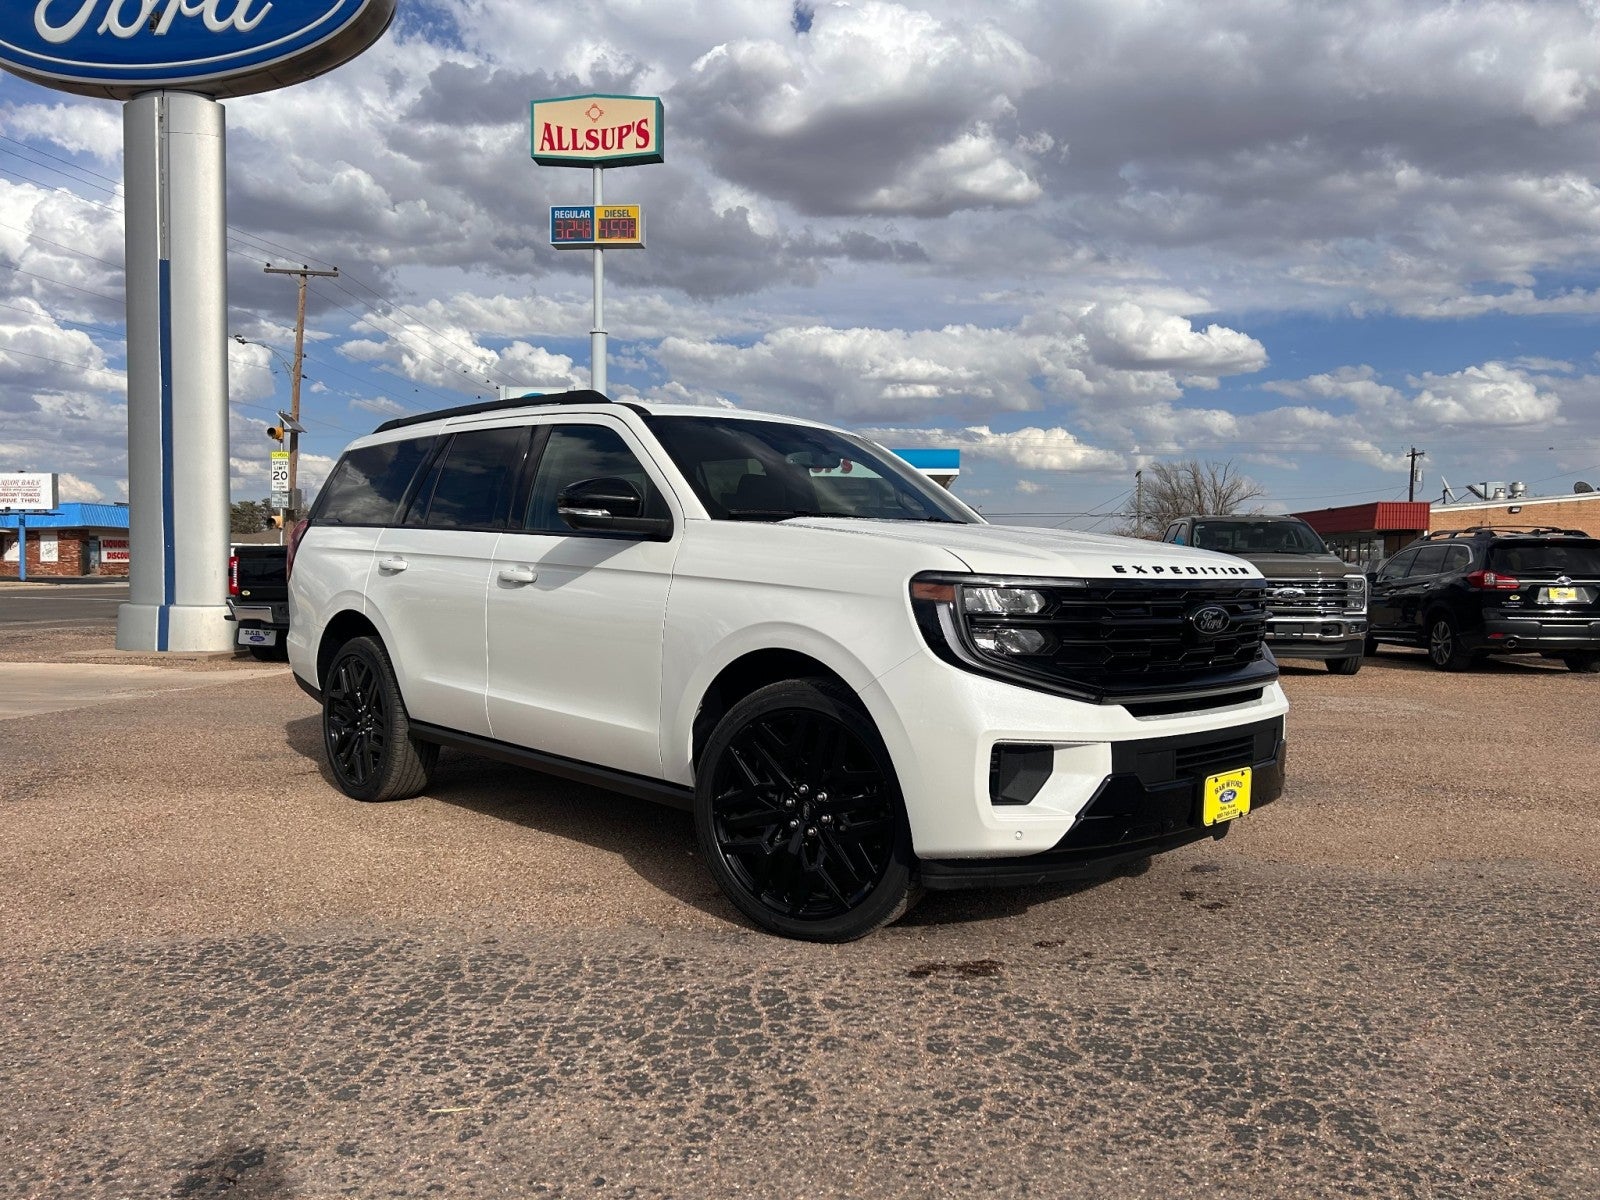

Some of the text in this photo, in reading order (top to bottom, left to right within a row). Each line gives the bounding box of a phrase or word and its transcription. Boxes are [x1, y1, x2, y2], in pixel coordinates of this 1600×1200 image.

[539, 118, 650, 151] ALLSUP'S
[554, 210, 591, 219] REGULAR
[604, 209, 631, 218] DIESEL
[273, 471, 288, 480] 20
[1112, 565, 1250, 575] EXPEDITION
[1200, 610, 1224, 630] Ford
